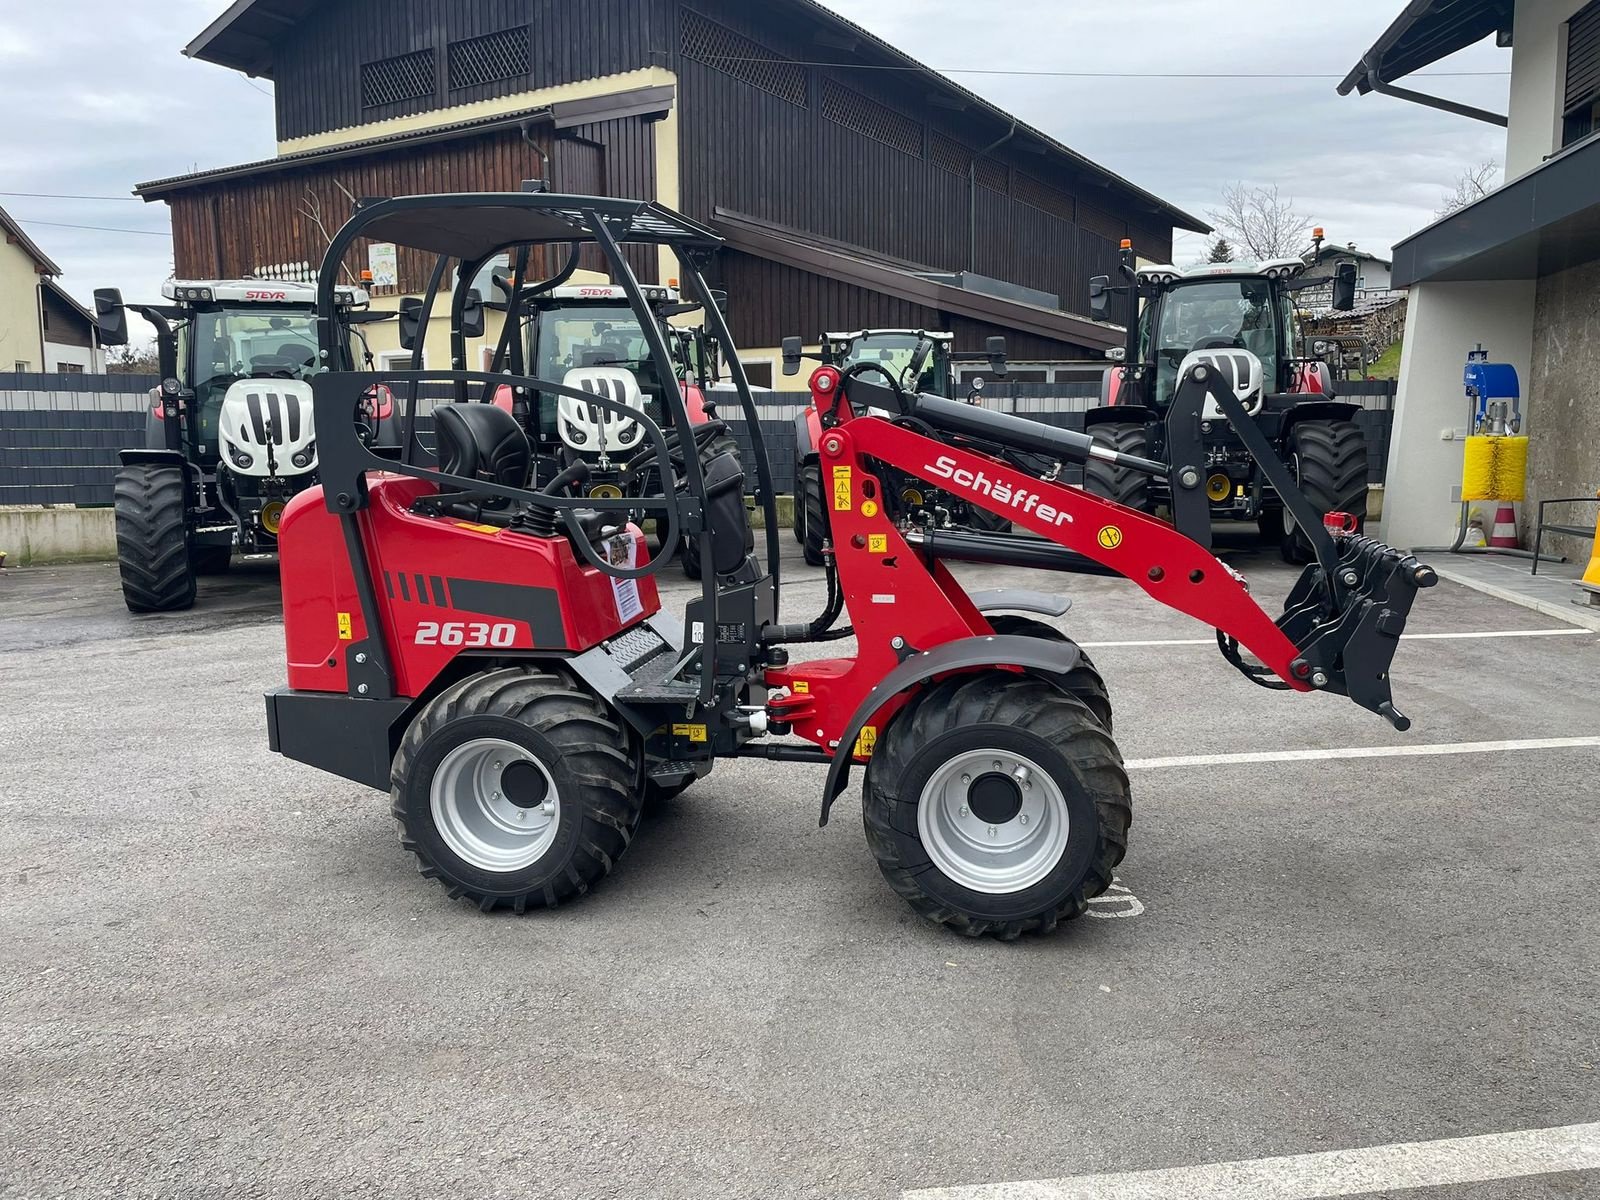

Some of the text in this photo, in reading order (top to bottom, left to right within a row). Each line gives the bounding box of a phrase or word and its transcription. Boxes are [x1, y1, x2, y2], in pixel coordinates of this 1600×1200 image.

[245, 290, 286, 299] STEYR
[579, 288, 613, 296] STEYR
[923, 455, 1074, 526] Schäffer
[414, 621, 517, 647] 2630
